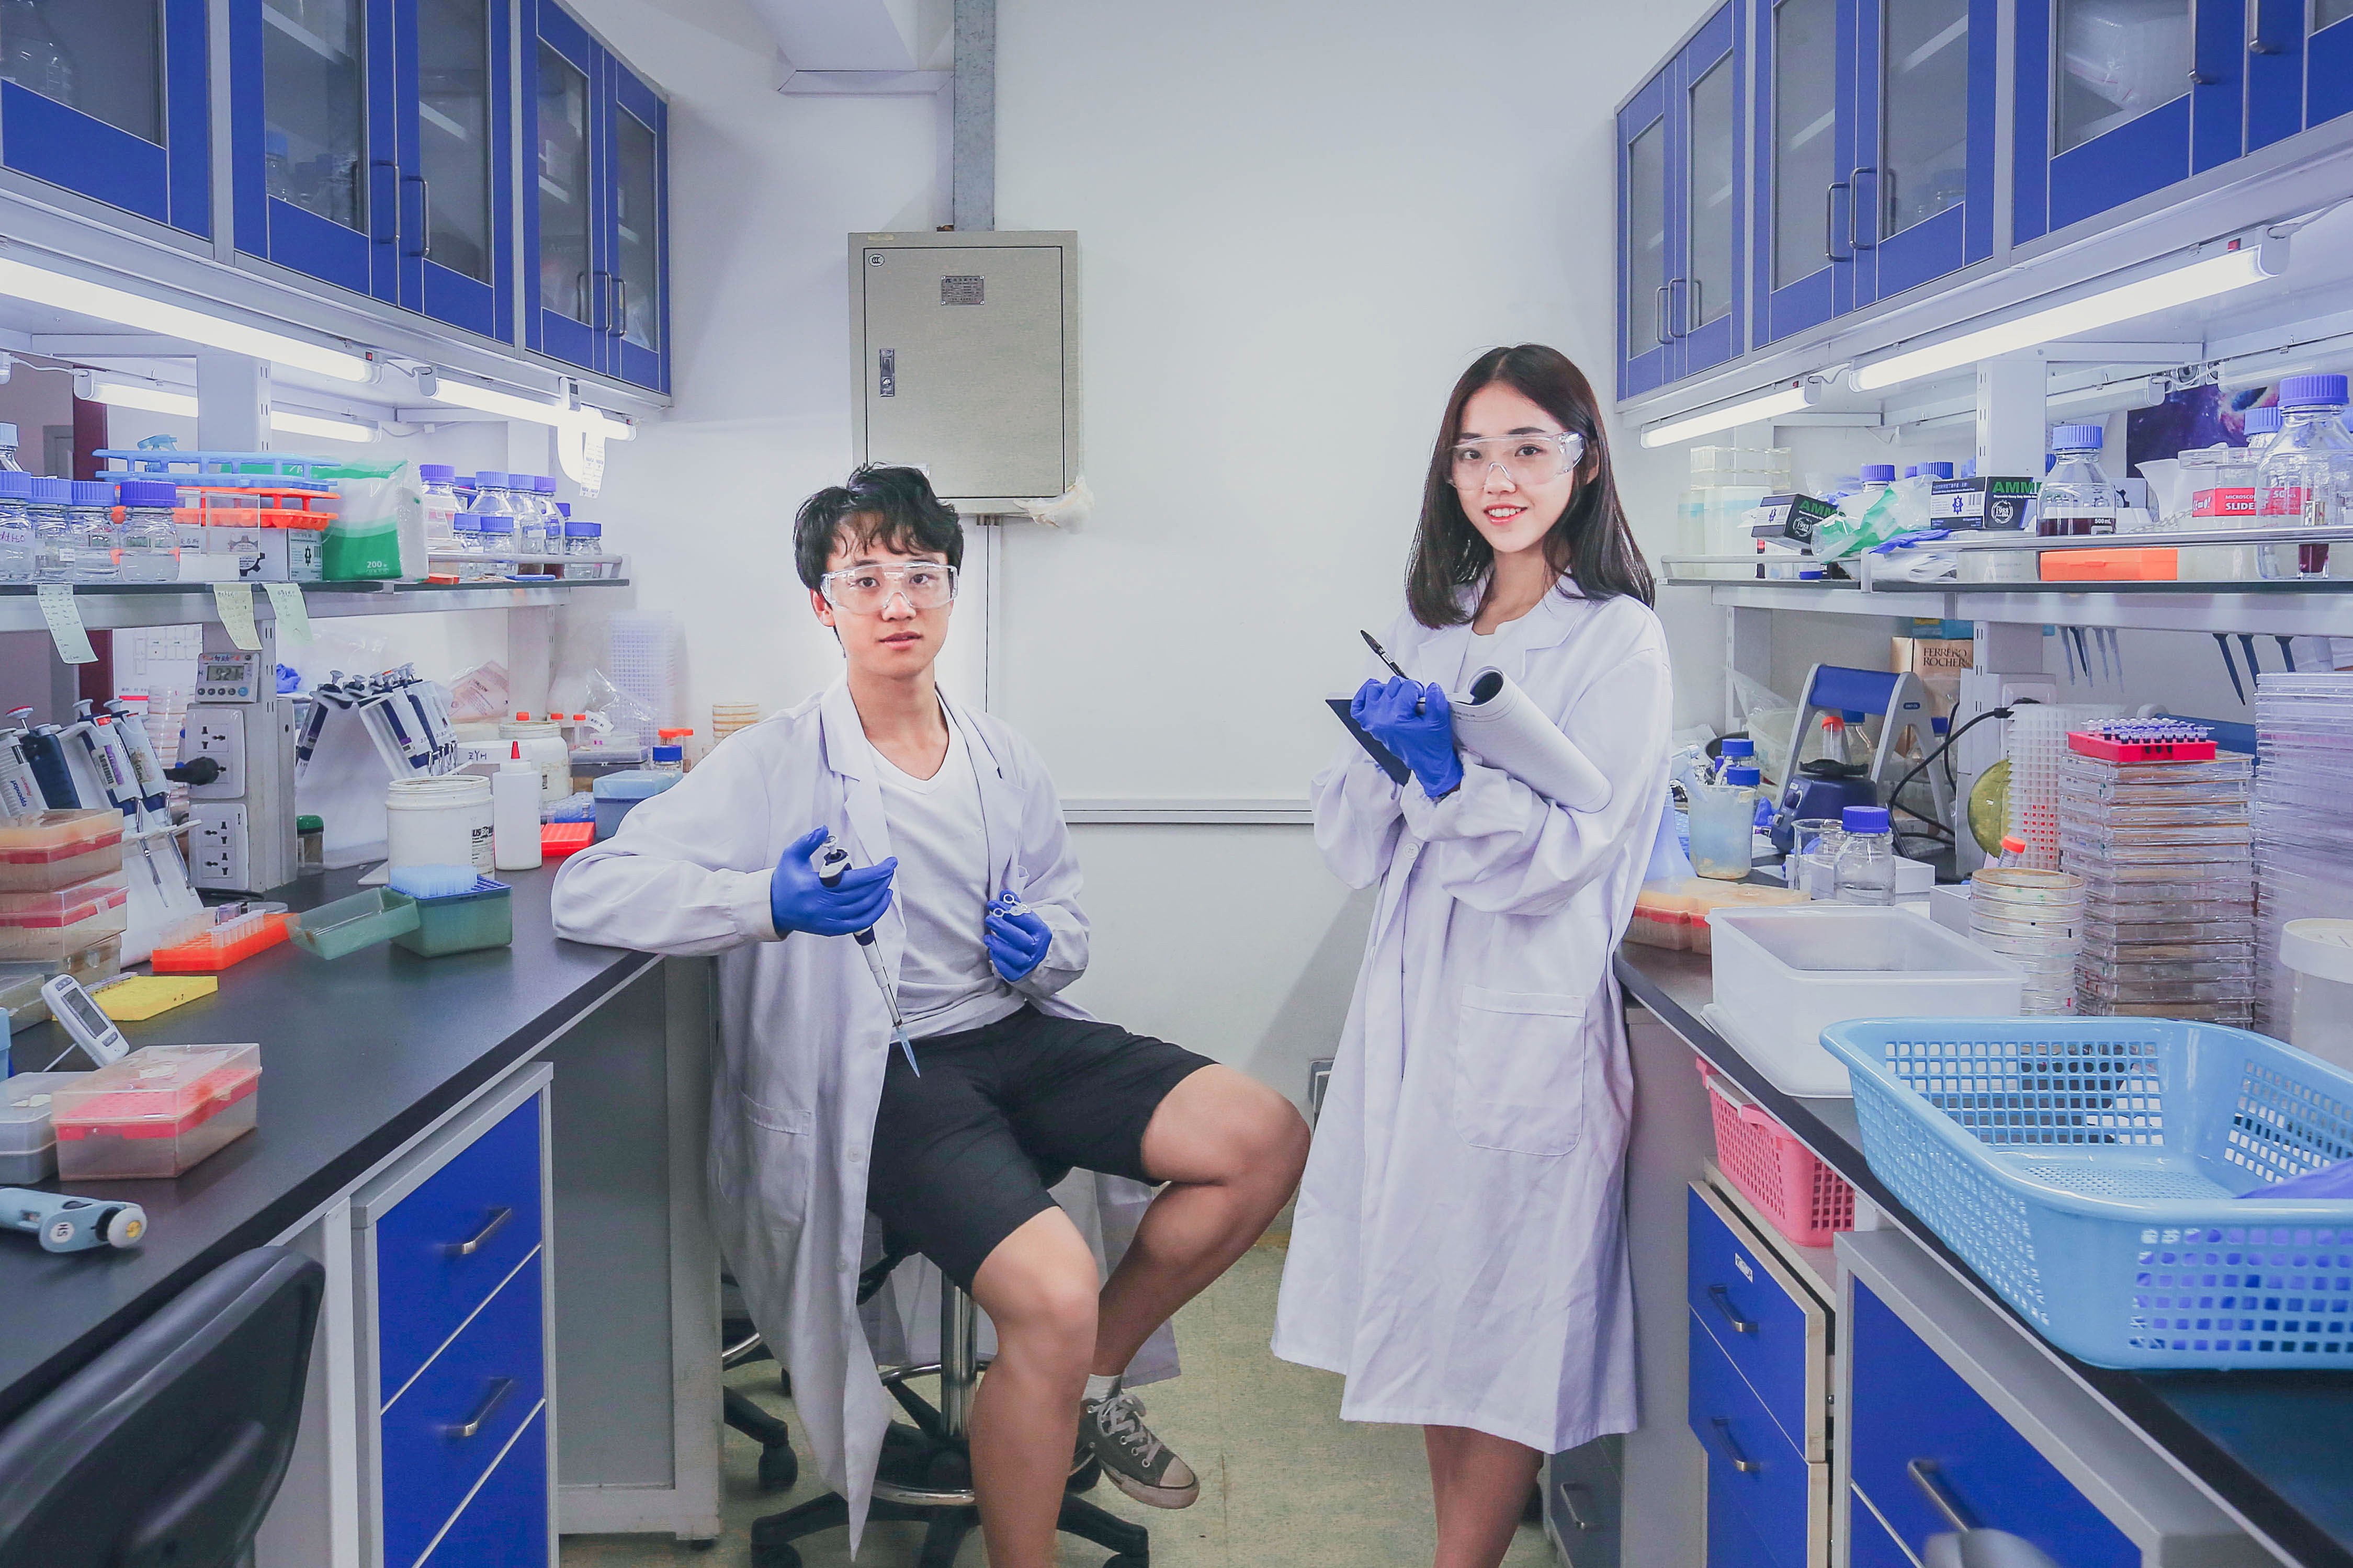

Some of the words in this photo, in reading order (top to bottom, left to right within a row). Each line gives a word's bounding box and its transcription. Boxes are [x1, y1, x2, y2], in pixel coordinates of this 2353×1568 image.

[2225, 502, 2256, 510] SLIDE
[1923, 647, 1967, 657] FERRERO
[1923, 656, 1966, 667] ROCHER
[469, 750, 487, 761] ZYH
[10, 780, 27, 807] eppendorf
